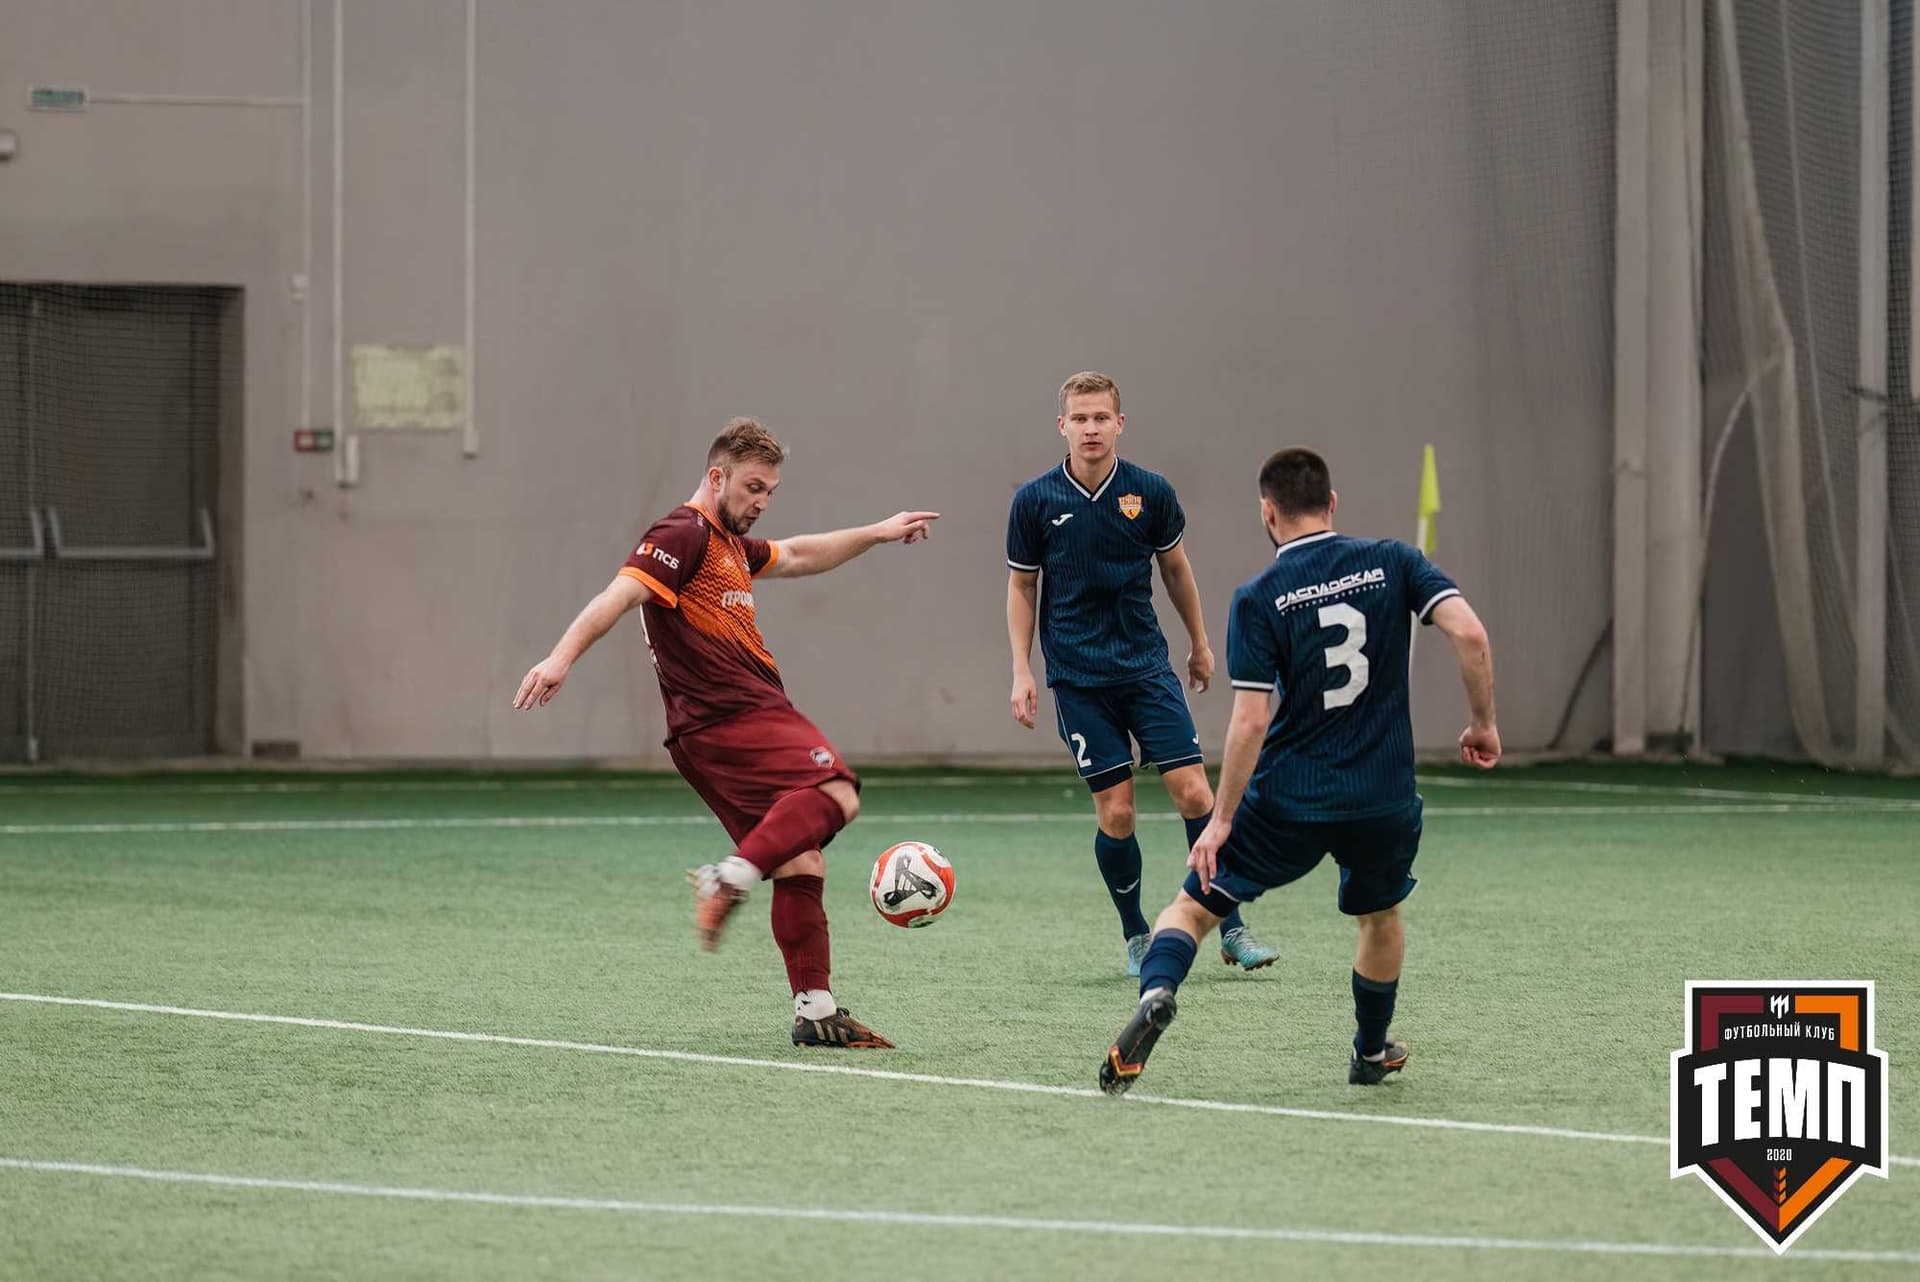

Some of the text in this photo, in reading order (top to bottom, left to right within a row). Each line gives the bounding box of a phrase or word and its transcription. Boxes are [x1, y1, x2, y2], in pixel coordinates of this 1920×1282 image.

[653, 548, 680, 569] ПСБ
[1317, 602, 1369, 711] 3
[1071, 733, 1092, 767] 2
